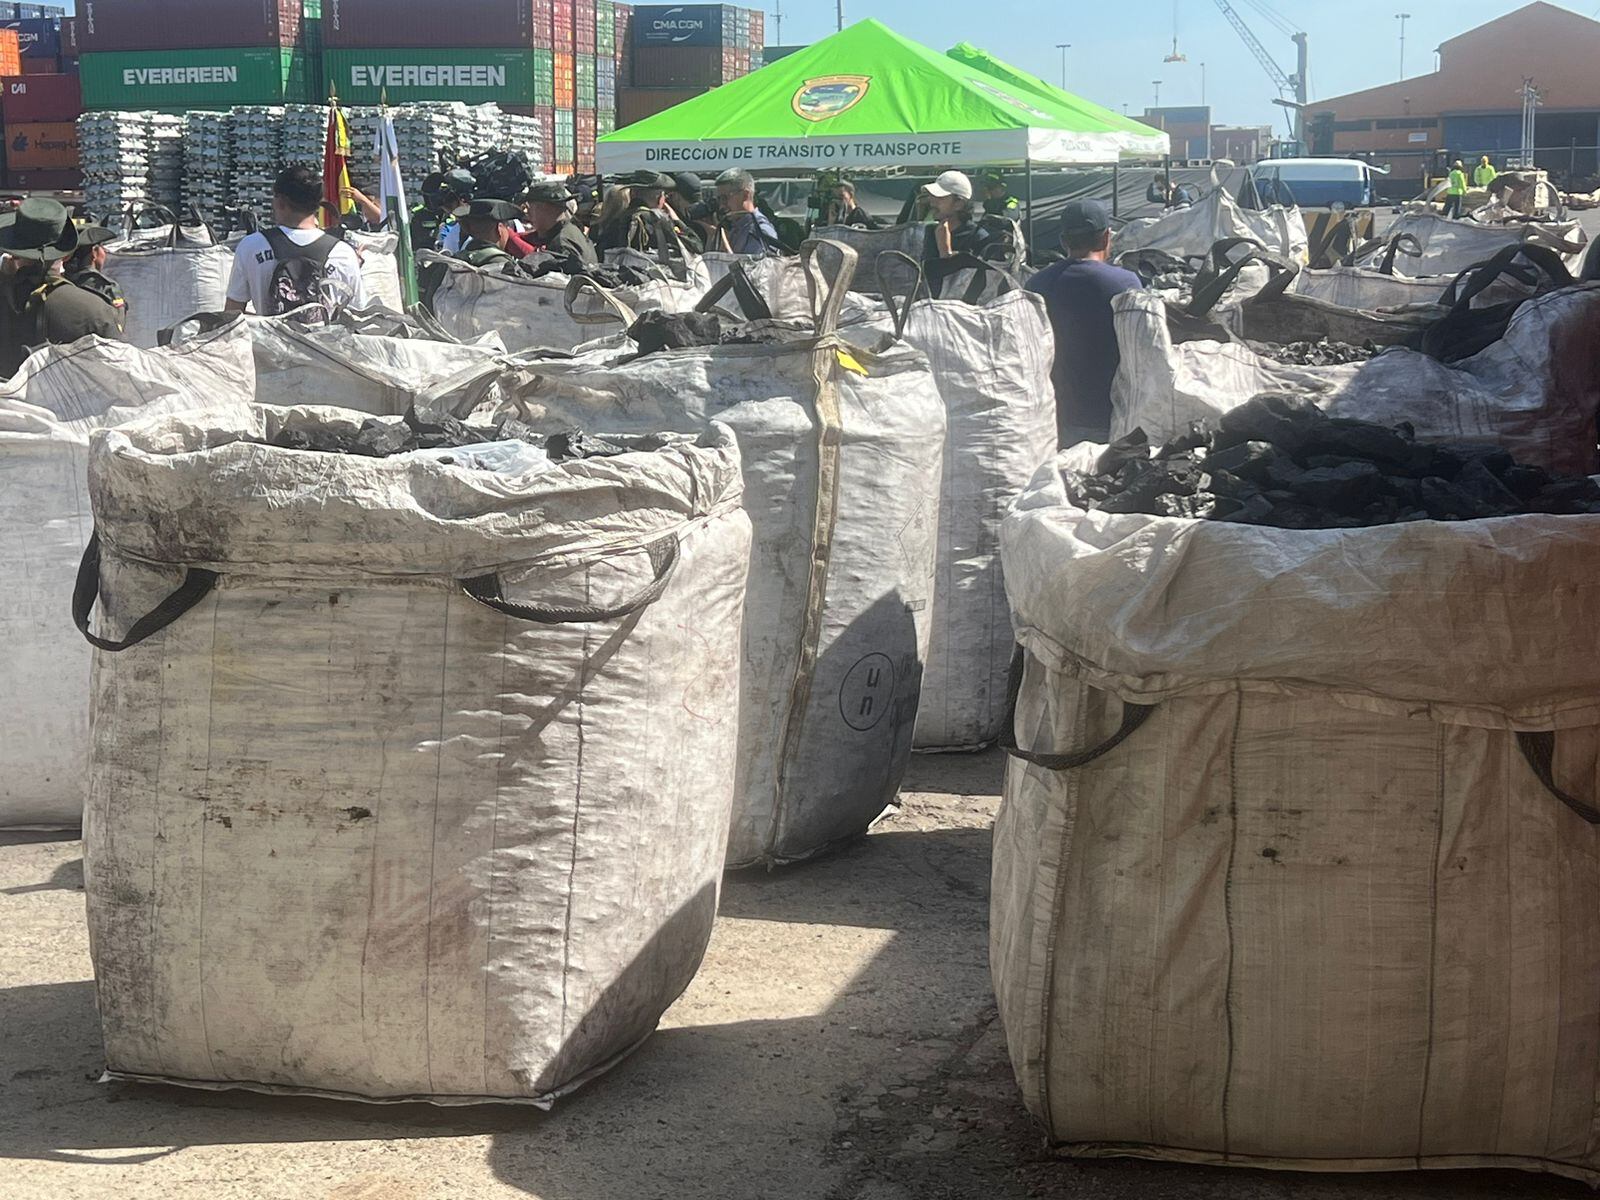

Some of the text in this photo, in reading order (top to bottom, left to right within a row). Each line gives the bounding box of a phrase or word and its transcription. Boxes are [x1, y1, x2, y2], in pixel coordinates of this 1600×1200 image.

[653, 20, 703, 29] CMA CGM
[123, 66, 237, 85] EVERGREEN
[351, 65, 506, 86] EVERGREEN
[11, 83, 27, 94] CAI
[645, 141, 961, 161] DIRECCIÓN DE TRÁNSITO Y TRANSPORTE
